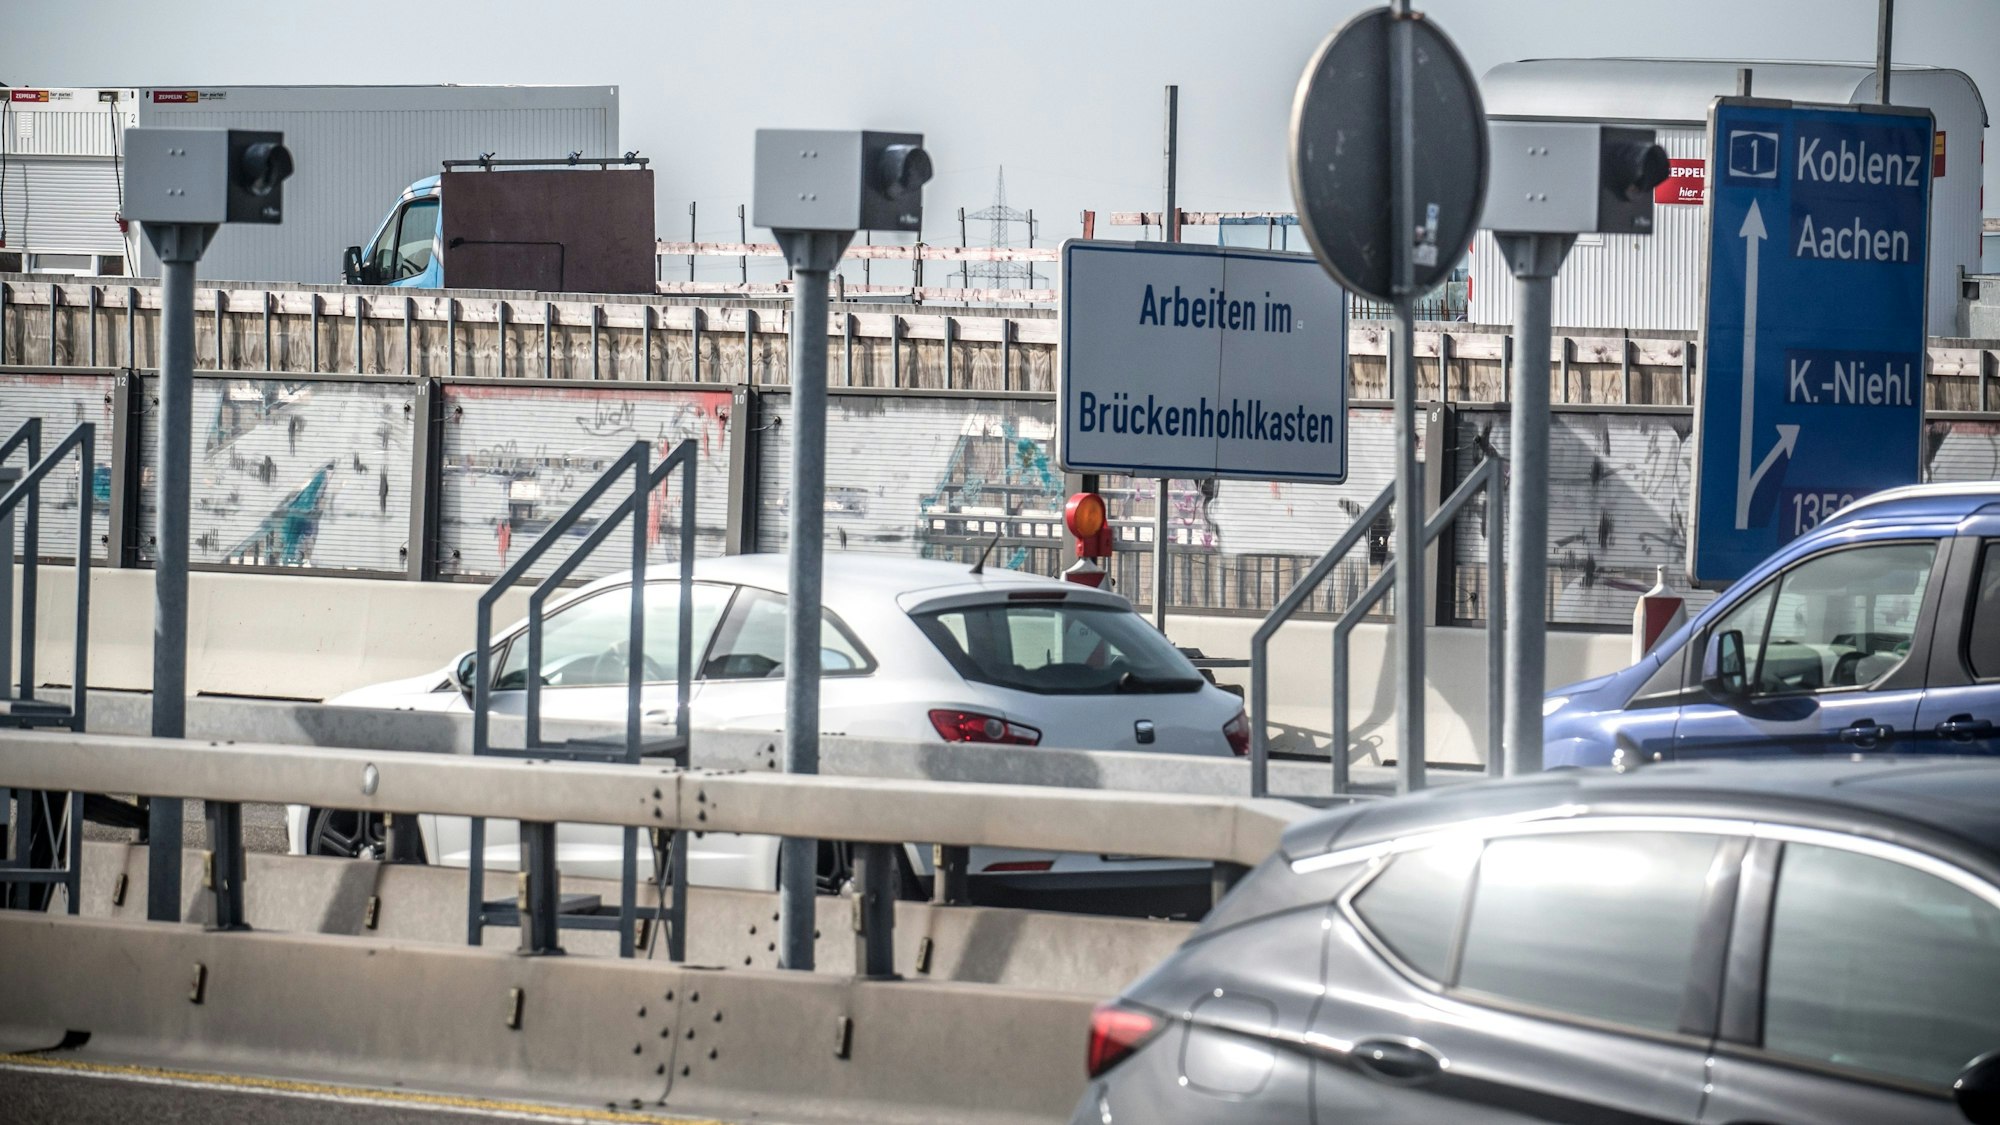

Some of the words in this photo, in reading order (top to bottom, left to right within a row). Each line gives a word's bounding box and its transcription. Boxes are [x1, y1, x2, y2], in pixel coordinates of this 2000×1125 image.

[1669, 167, 1704, 178] EPPEL
[1750, 139, 1758, 172] 1
[1797, 136, 1922, 187] Koblenz
[1679, 186, 1698, 197] hier
[1796, 214, 1910, 262] Aachen
[1139, 284, 1256, 331] Arbeiten
[1264, 291, 1292, 333] im
[1789, 358, 1912, 406] K.-Niehl
[1079, 391, 1334, 444] Brückenhohlkasten
